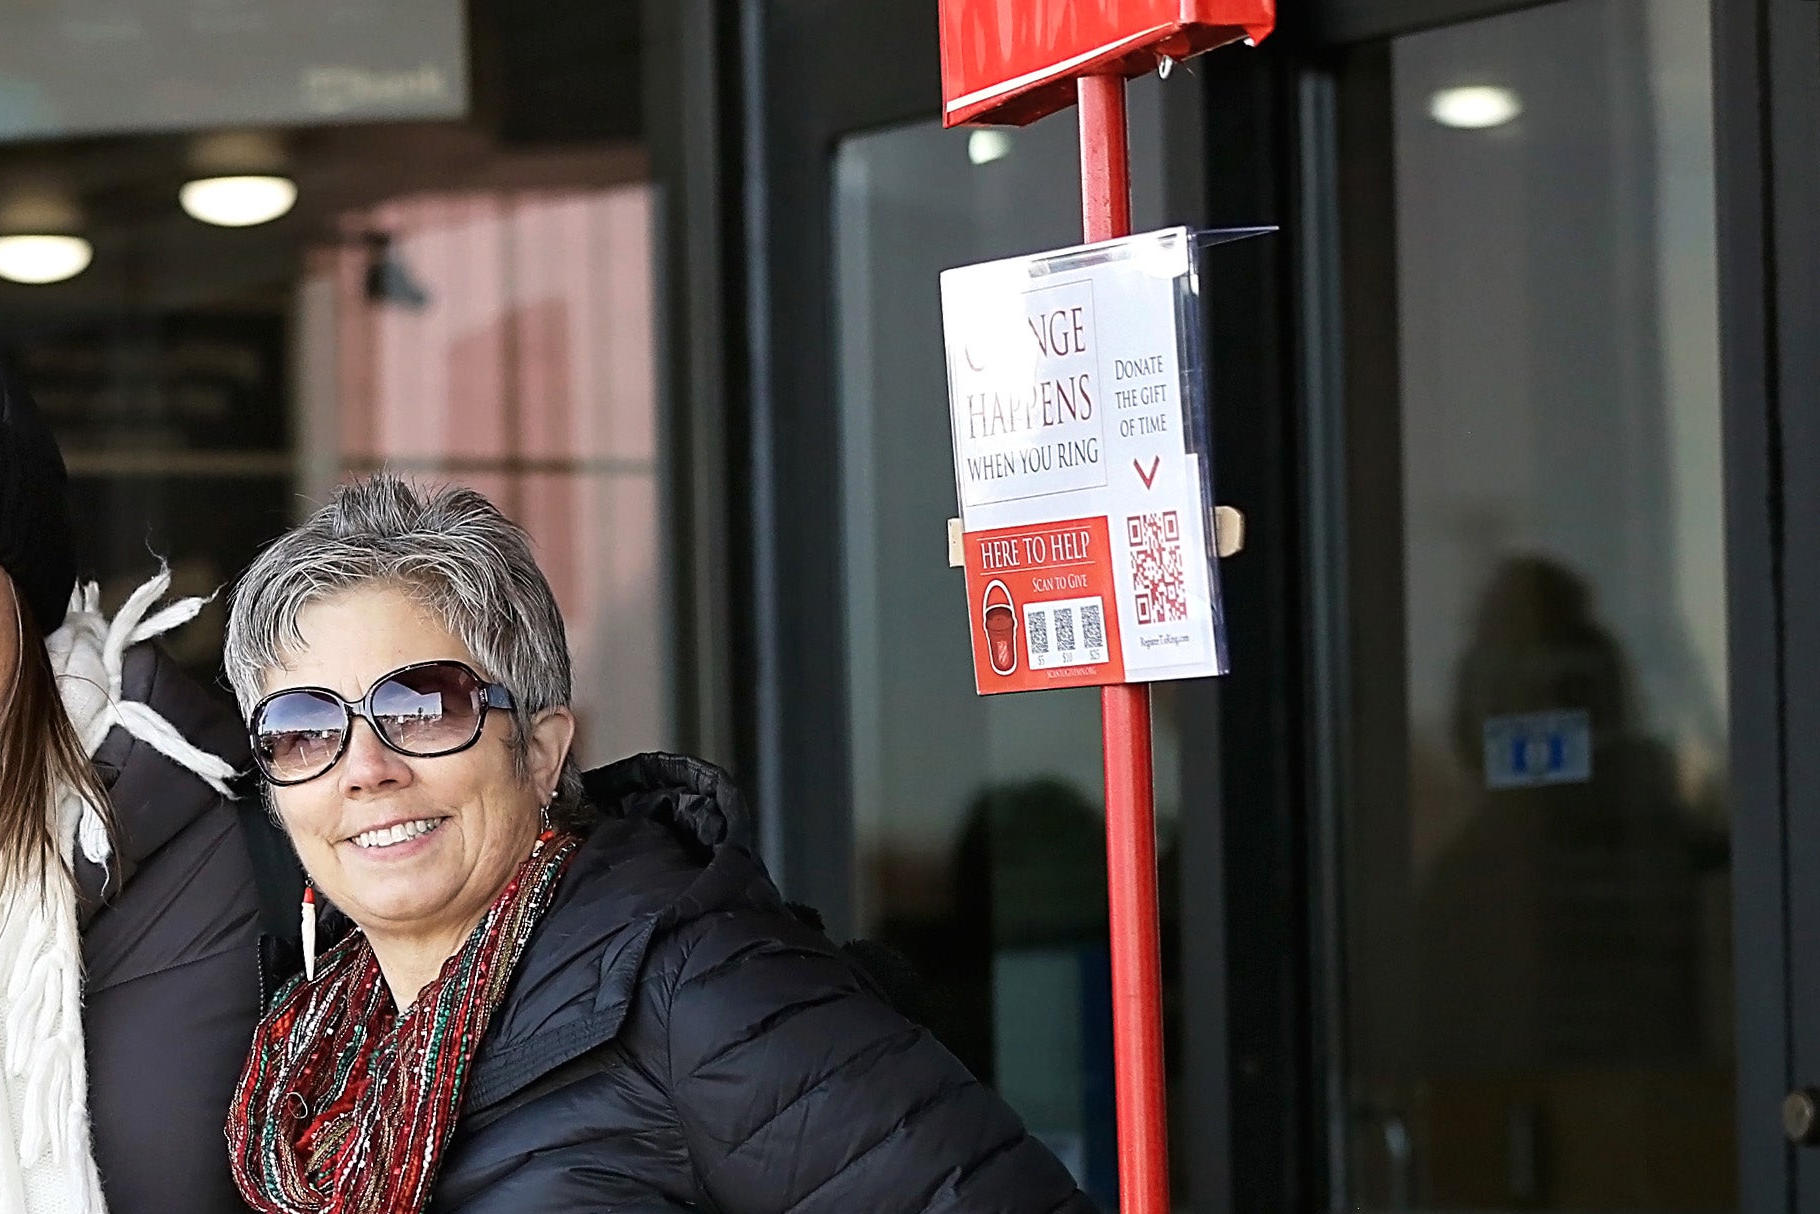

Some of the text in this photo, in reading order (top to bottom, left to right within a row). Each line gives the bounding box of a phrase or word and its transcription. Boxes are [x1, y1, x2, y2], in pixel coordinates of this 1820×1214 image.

[1114, 355, 1164, 381] DONATE
[1115, 383, 1167, 409] THE GIFT
[1120, 413, 1167, 438] OF TIME
[968, 437, 1098, 481] WHEN YOU RING
[980, 531, 1090, 570] HERE TO HELP
[1032, 577, 1053, 592] SCAN
[1068, 573, 1088, 588] GIVE
